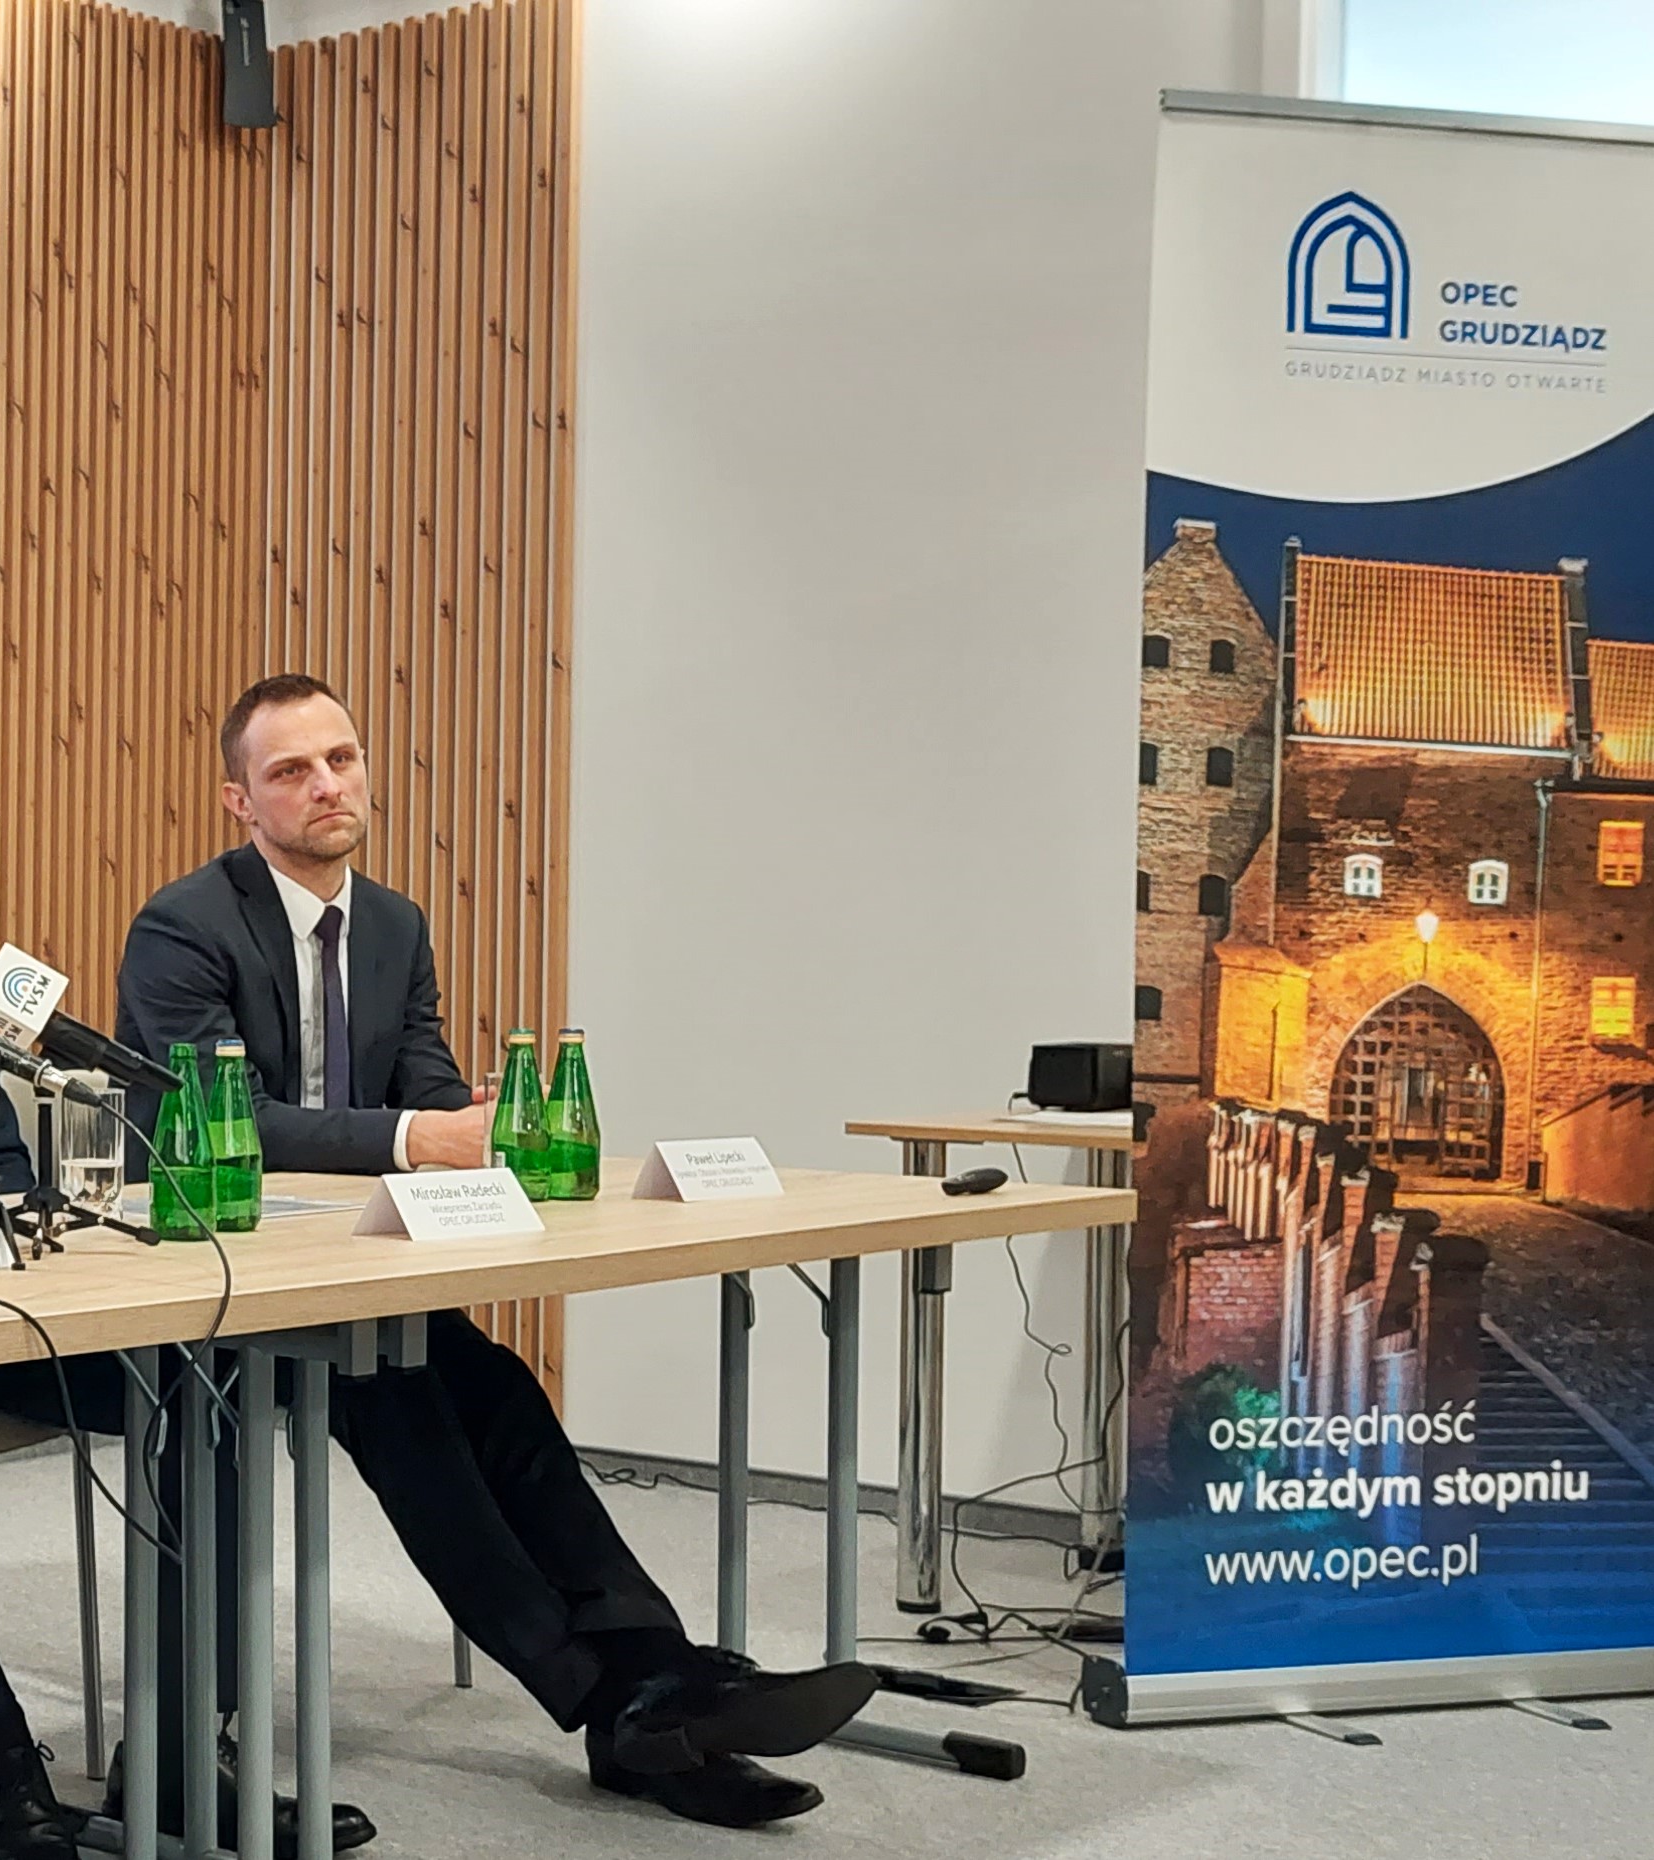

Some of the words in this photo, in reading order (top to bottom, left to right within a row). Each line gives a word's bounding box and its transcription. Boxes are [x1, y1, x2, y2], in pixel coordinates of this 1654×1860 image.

[1440, 281, 1518, 307] OPEC
[1438, 320, 1608, 353] GRUDZIĄDZ
[1285, 361, 1406, 383] GRUDZIĄDZ
[1417, 367, 1496, 388] MIASTO
[1506, 373, 1607, 393] OTWARTE
[22, 975, 52, 1016] TVSM
[461, 1182, 507, 1198] Radecki
[1208, 1399, 1478, 1457] oszczędność
[1205, 1480, 1244, 1514] w
[1255, 1466, 1422, 1519] każdym
[1432, 1459, 1590, 1513] stopniu
[1204, 1533, 1478, 1590] www.opec.pl
